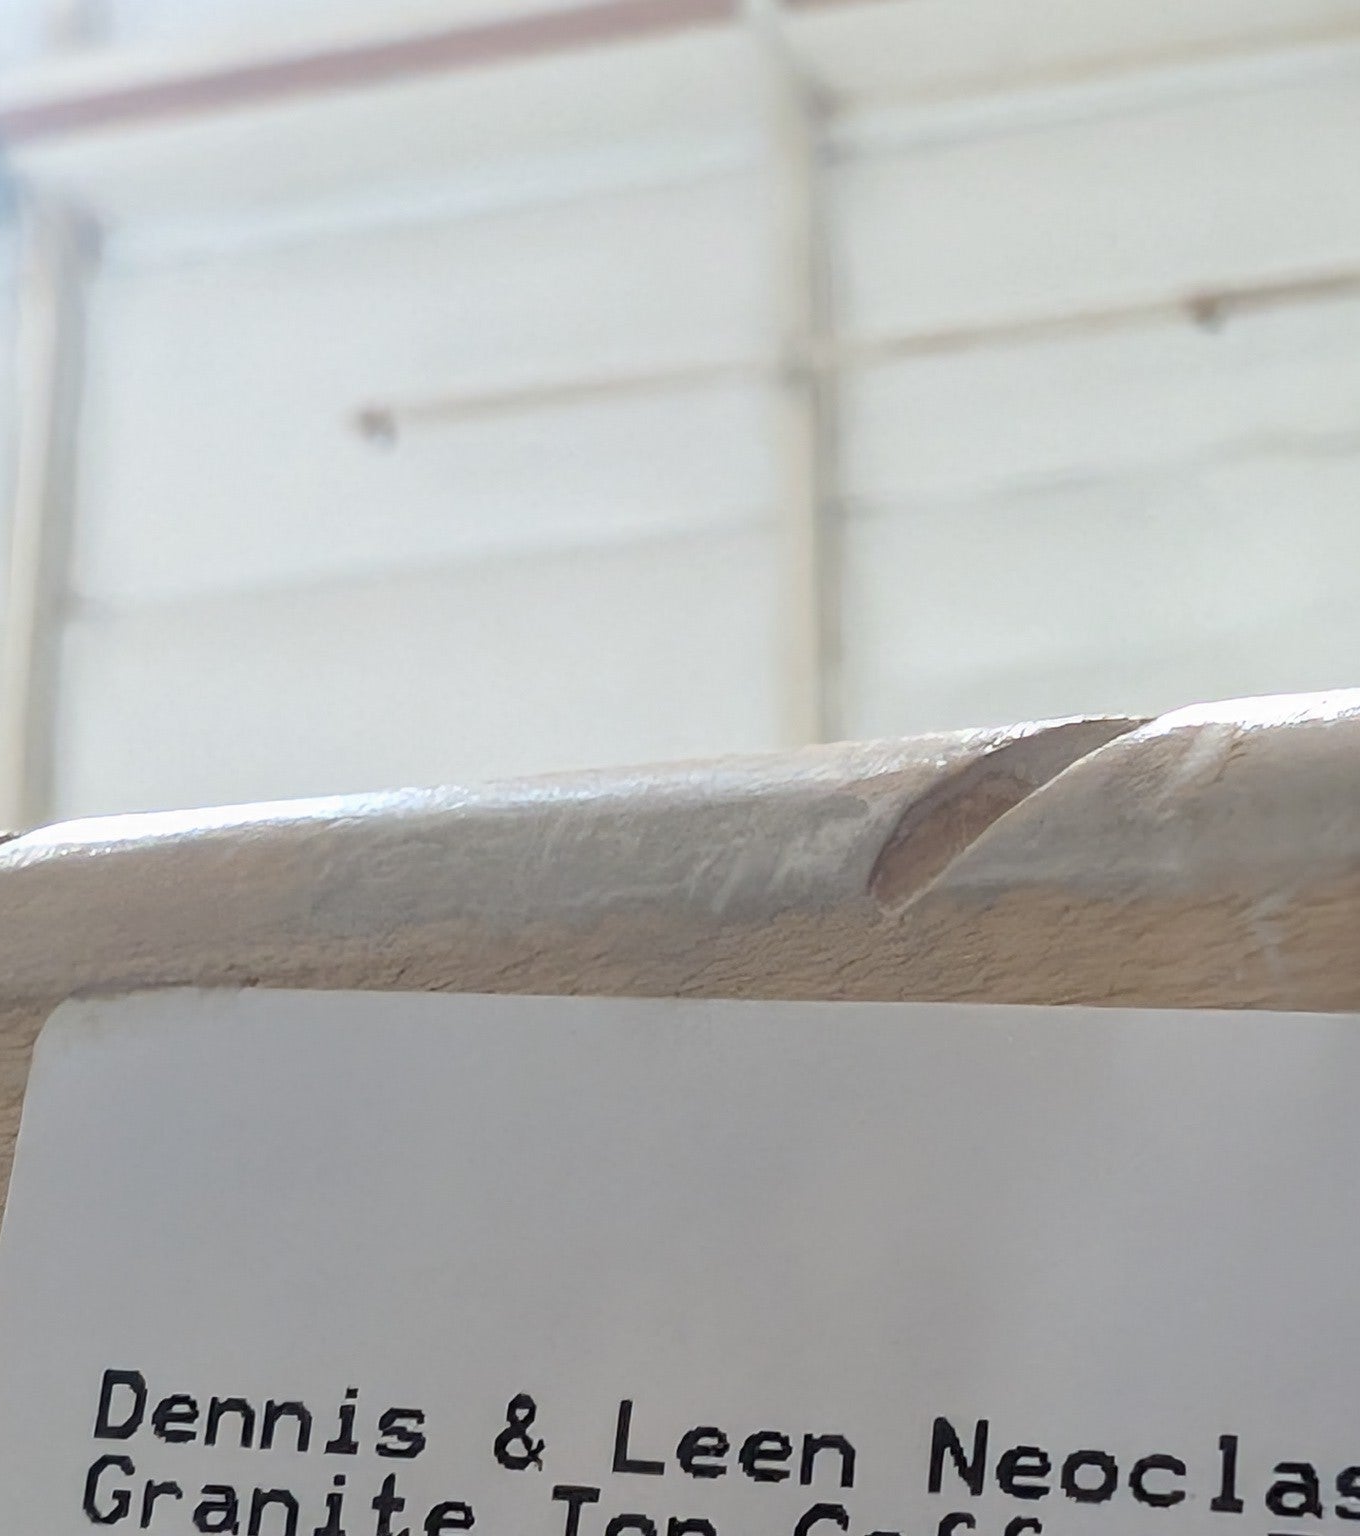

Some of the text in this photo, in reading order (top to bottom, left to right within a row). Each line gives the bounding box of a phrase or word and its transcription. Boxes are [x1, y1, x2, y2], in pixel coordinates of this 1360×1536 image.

[93, 1368, 427, 1459] Dennis
[493, 1392, 546, 1472] &
[611, 1398, 857, 1489] Leen
